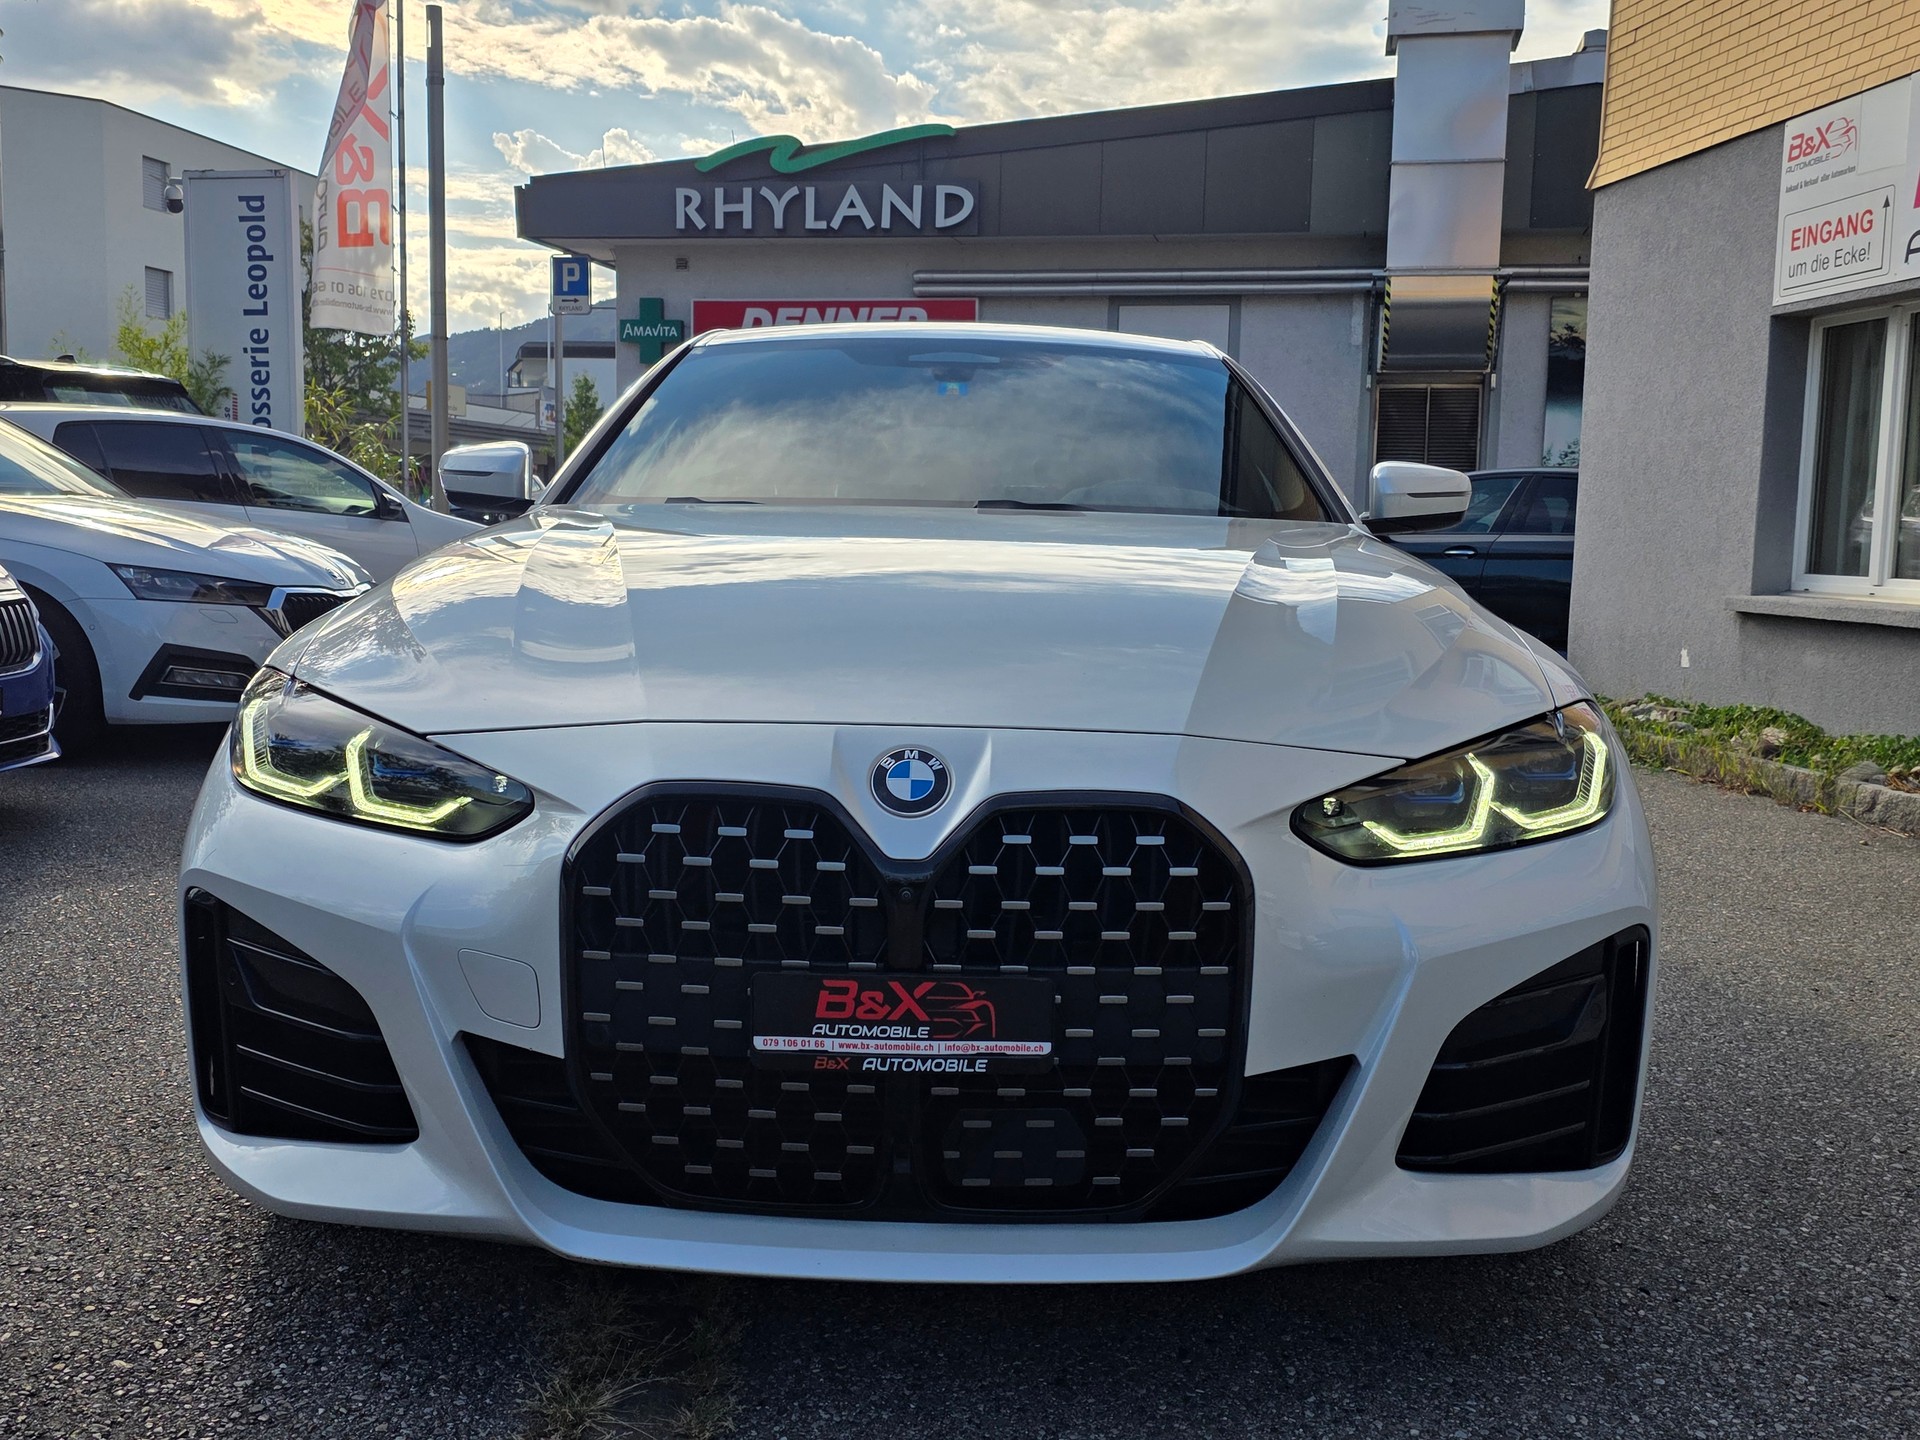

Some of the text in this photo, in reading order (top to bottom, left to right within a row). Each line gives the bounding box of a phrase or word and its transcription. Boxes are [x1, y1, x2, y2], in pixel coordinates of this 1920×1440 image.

[1787, 120, 1835, 163] B&X
[1785, 152, 1831, 175] AUTOMOBILE
[675, 183, 974, 231] RHYLAND
[1790, 208, 1874, 252] EINGANG
[238, 195, 274, 316] Leopold
[1788, 241, 1871, 278] um die Ecke!
[562, 262, 580, 292] P
[880, 749, 943, 771] BMW
[815, 979, 937, 1021] B&X
[762, 1038, 1044, 1053] 079 106 01 66 www.bx-automobile.ch info@bx-automobile.ch
[812, 1023, 931, 1038] AUTOMOBILE
[814, 1056, 988, 1073] B&X AUTOMOBILE
